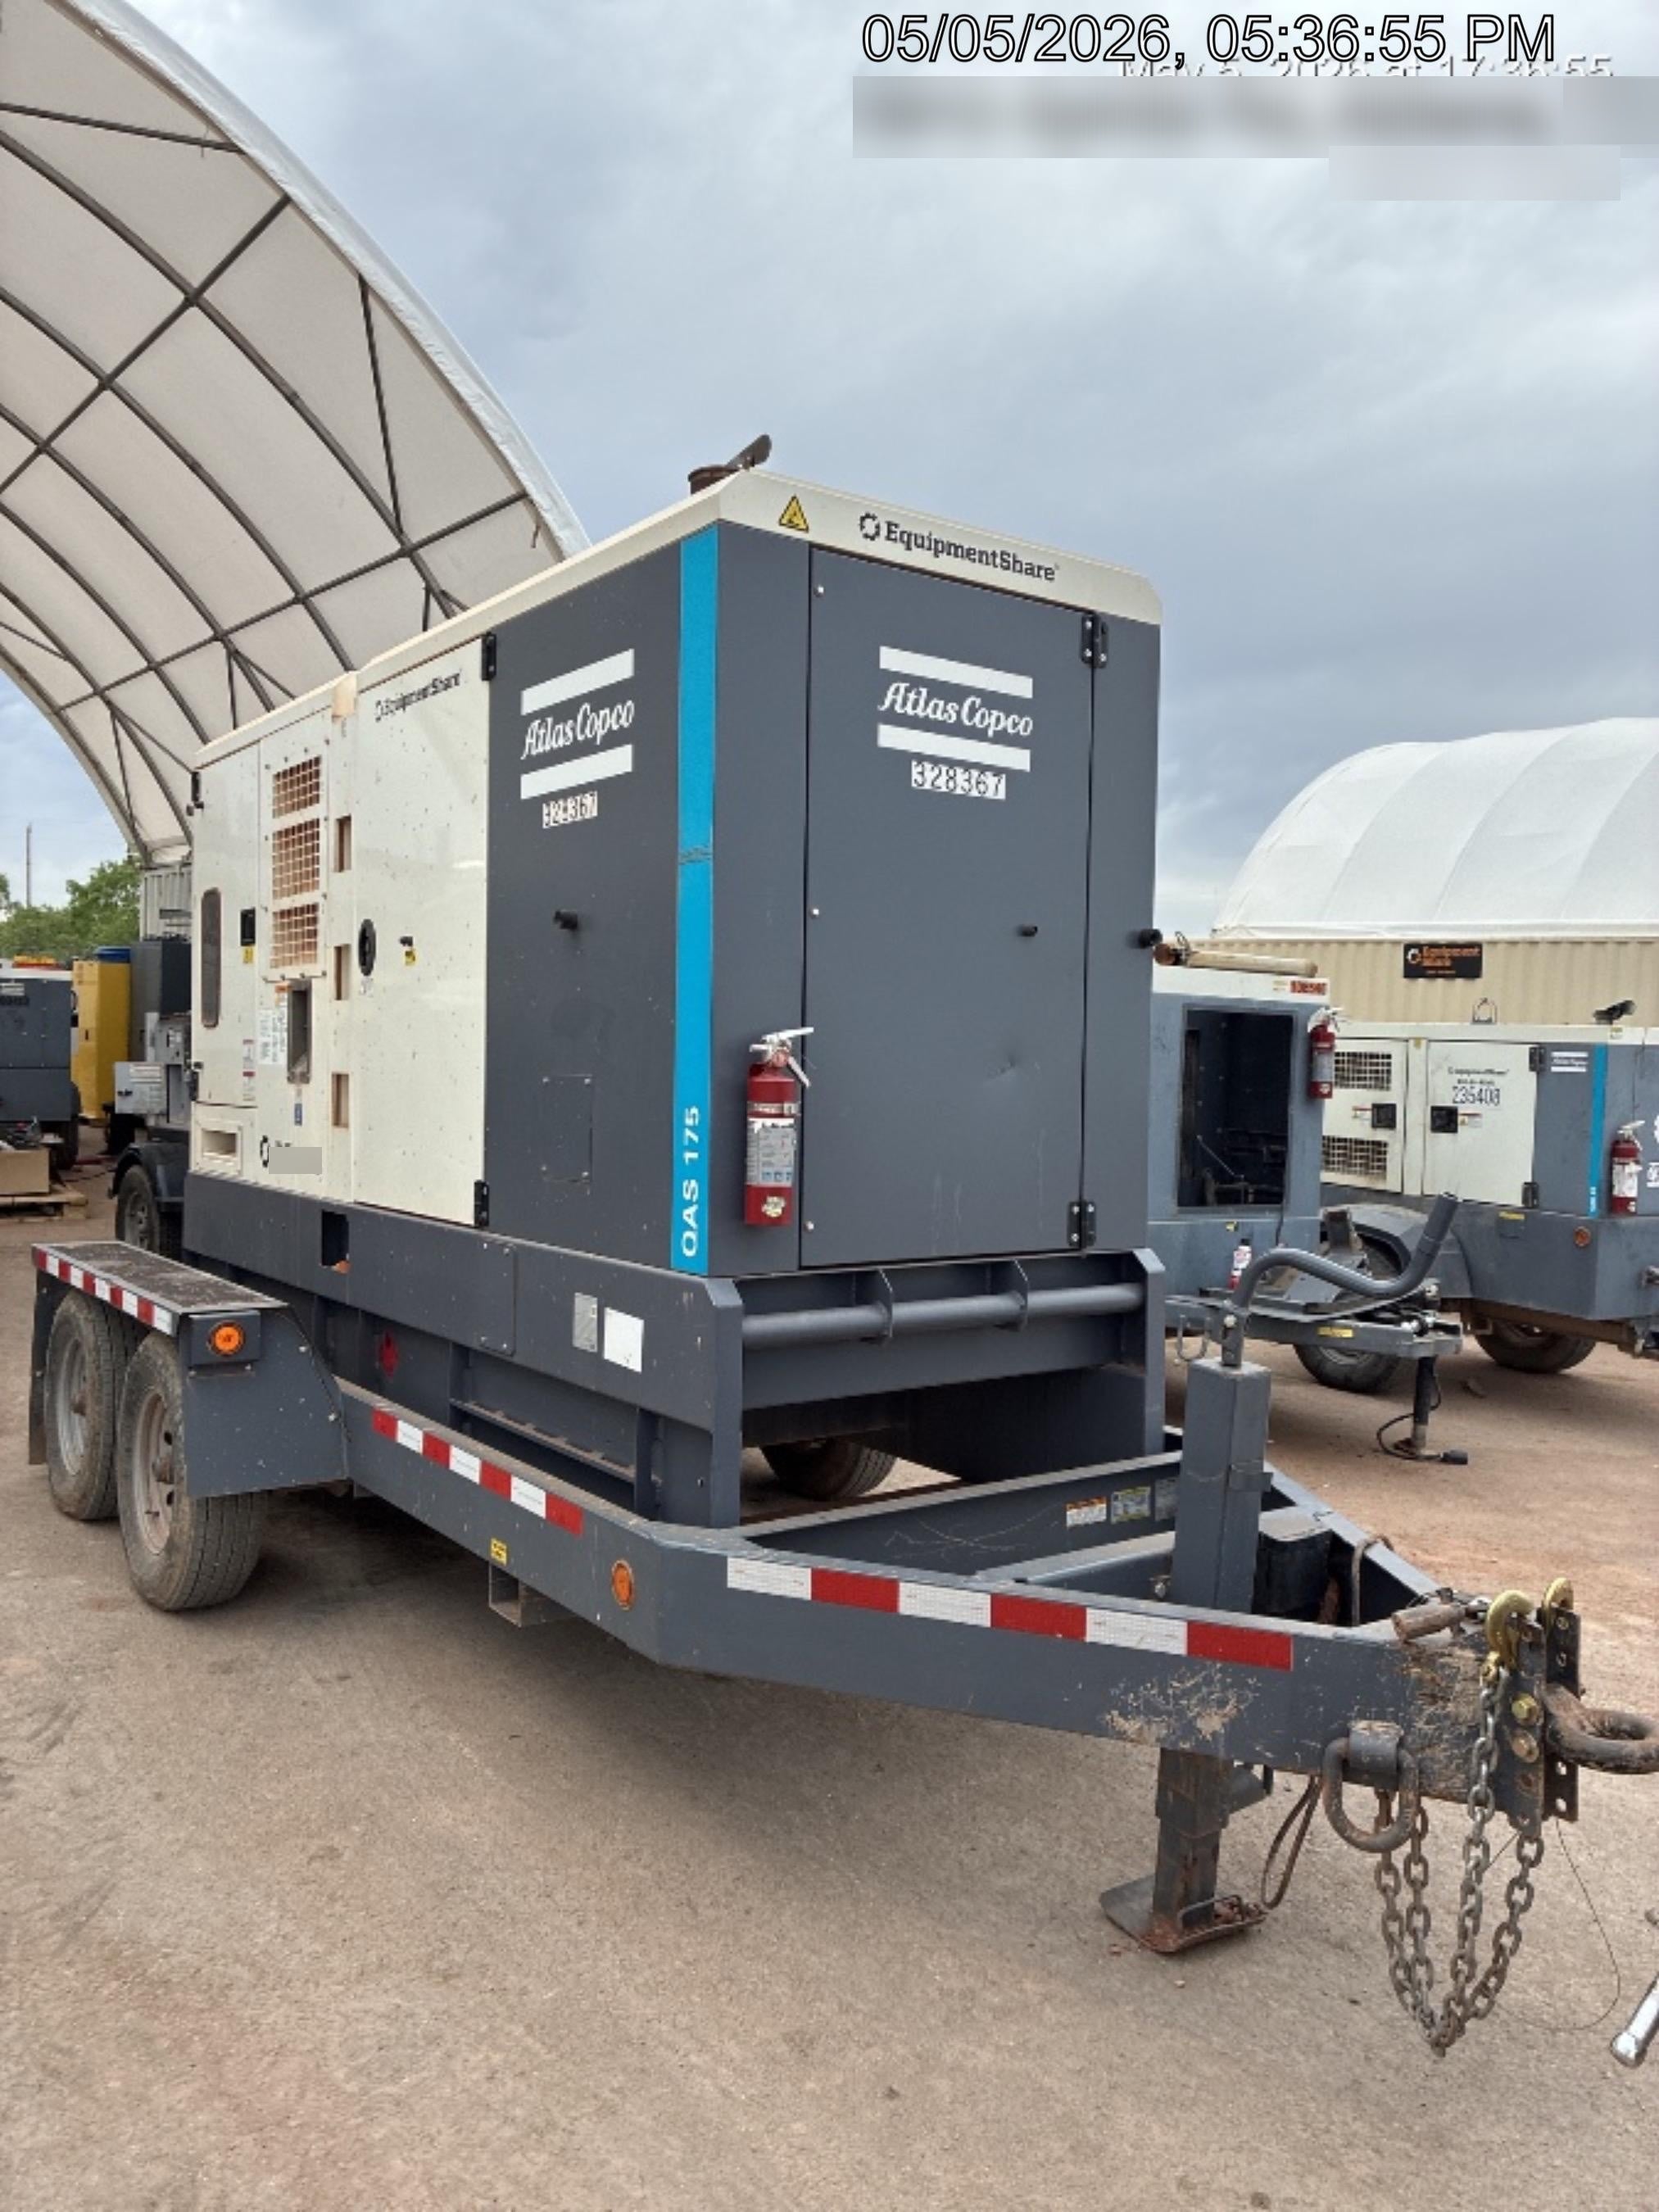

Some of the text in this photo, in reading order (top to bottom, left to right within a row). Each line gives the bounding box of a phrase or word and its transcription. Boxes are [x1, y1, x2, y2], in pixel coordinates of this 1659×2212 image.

[885, 520, 1056, 581] EquipmentShare
[520, 700, 635, 760] Atlas Copco
[877, 682, 1034, 738] Atlas Copco
[912, 759, 1004, 799] 328367
[682, 1104, 700, 1166] 175
